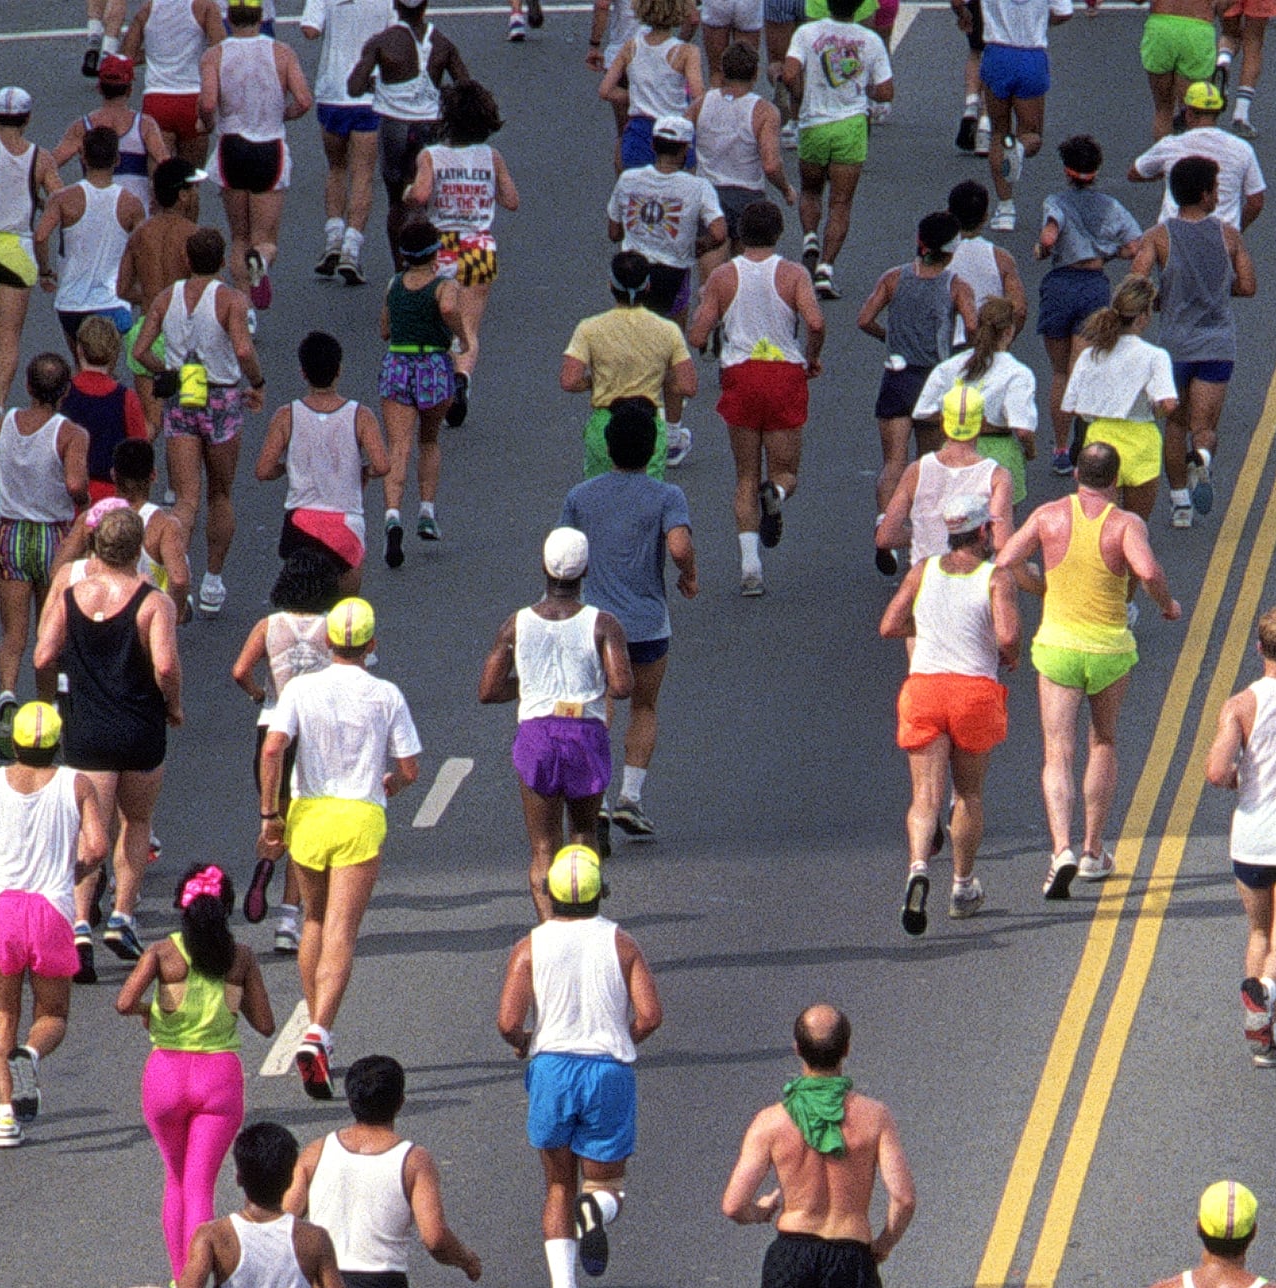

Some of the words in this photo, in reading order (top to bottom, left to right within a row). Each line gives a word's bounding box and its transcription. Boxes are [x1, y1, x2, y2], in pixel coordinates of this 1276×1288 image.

[436, 168, 492, 180] KATHLEEN
[442, 183, 488, 196] RUNNING
[433, 196, 454, 209] ALL
[456, 196, 476, 210] THE
